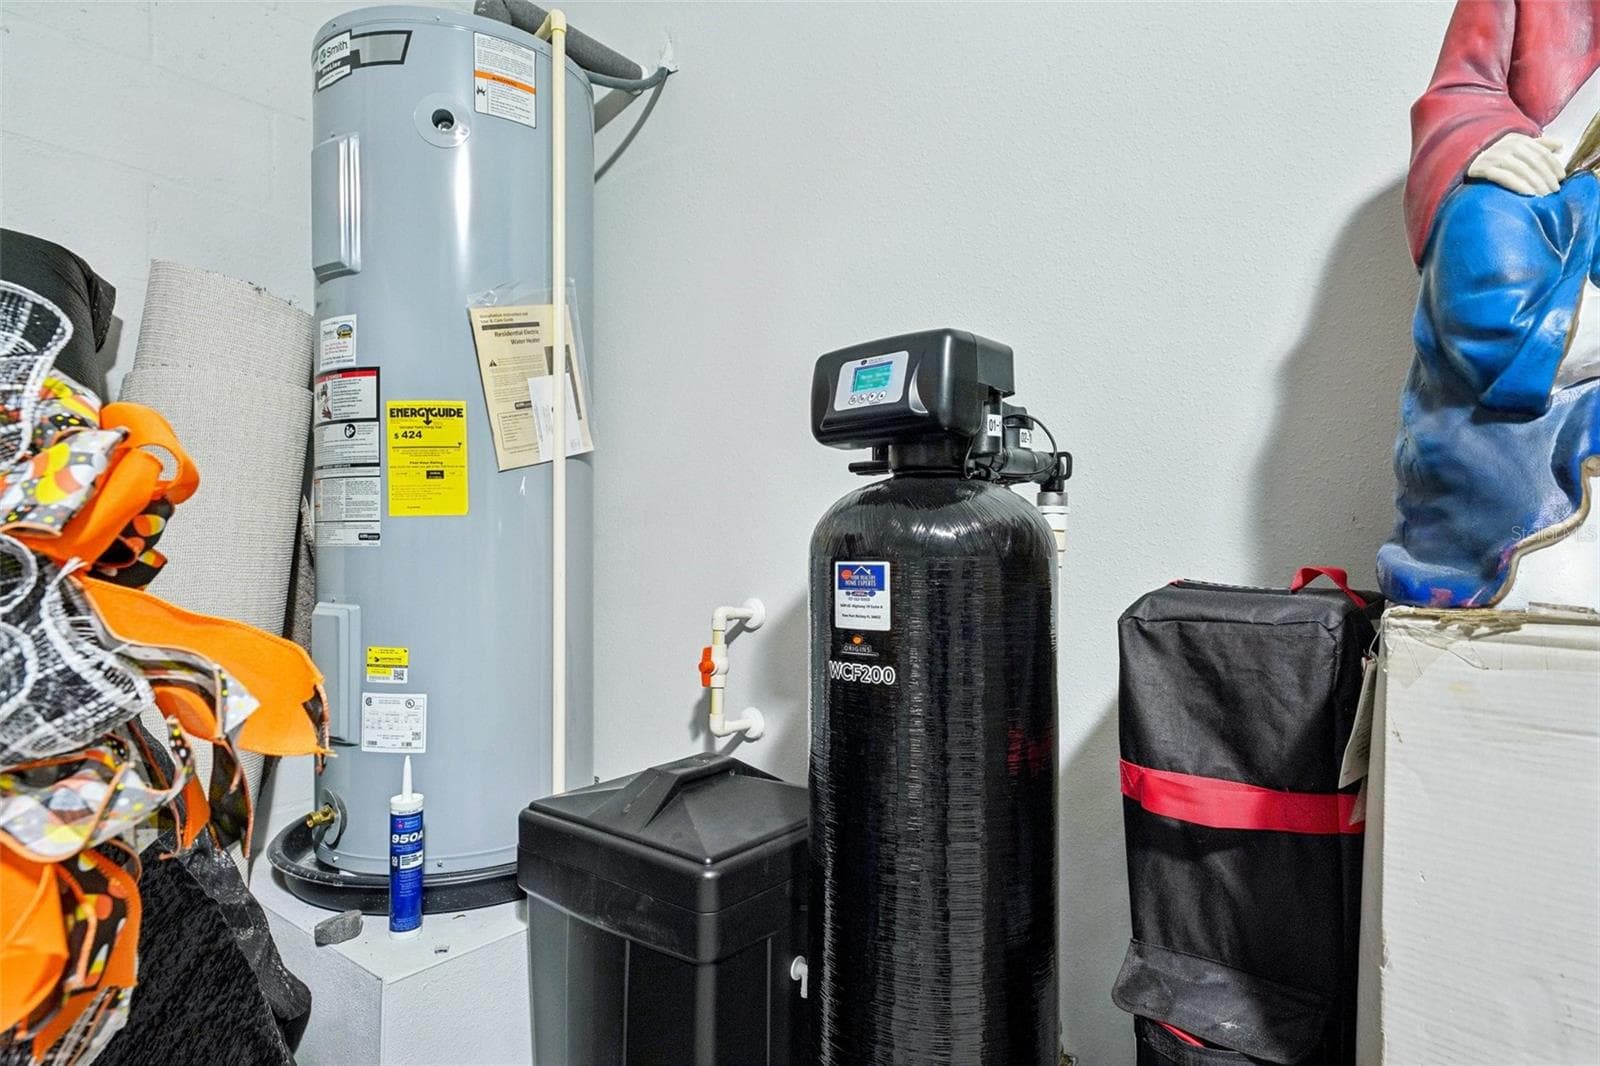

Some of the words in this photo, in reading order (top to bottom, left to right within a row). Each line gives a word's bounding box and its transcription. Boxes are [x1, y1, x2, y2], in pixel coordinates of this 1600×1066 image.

[326, 40, 348, 58] Smith
[390, 408, 464, 418] ENERGYGUIDE
[401, 430, 423, 439] 424
[828, 660, 896, 686] WCF200
